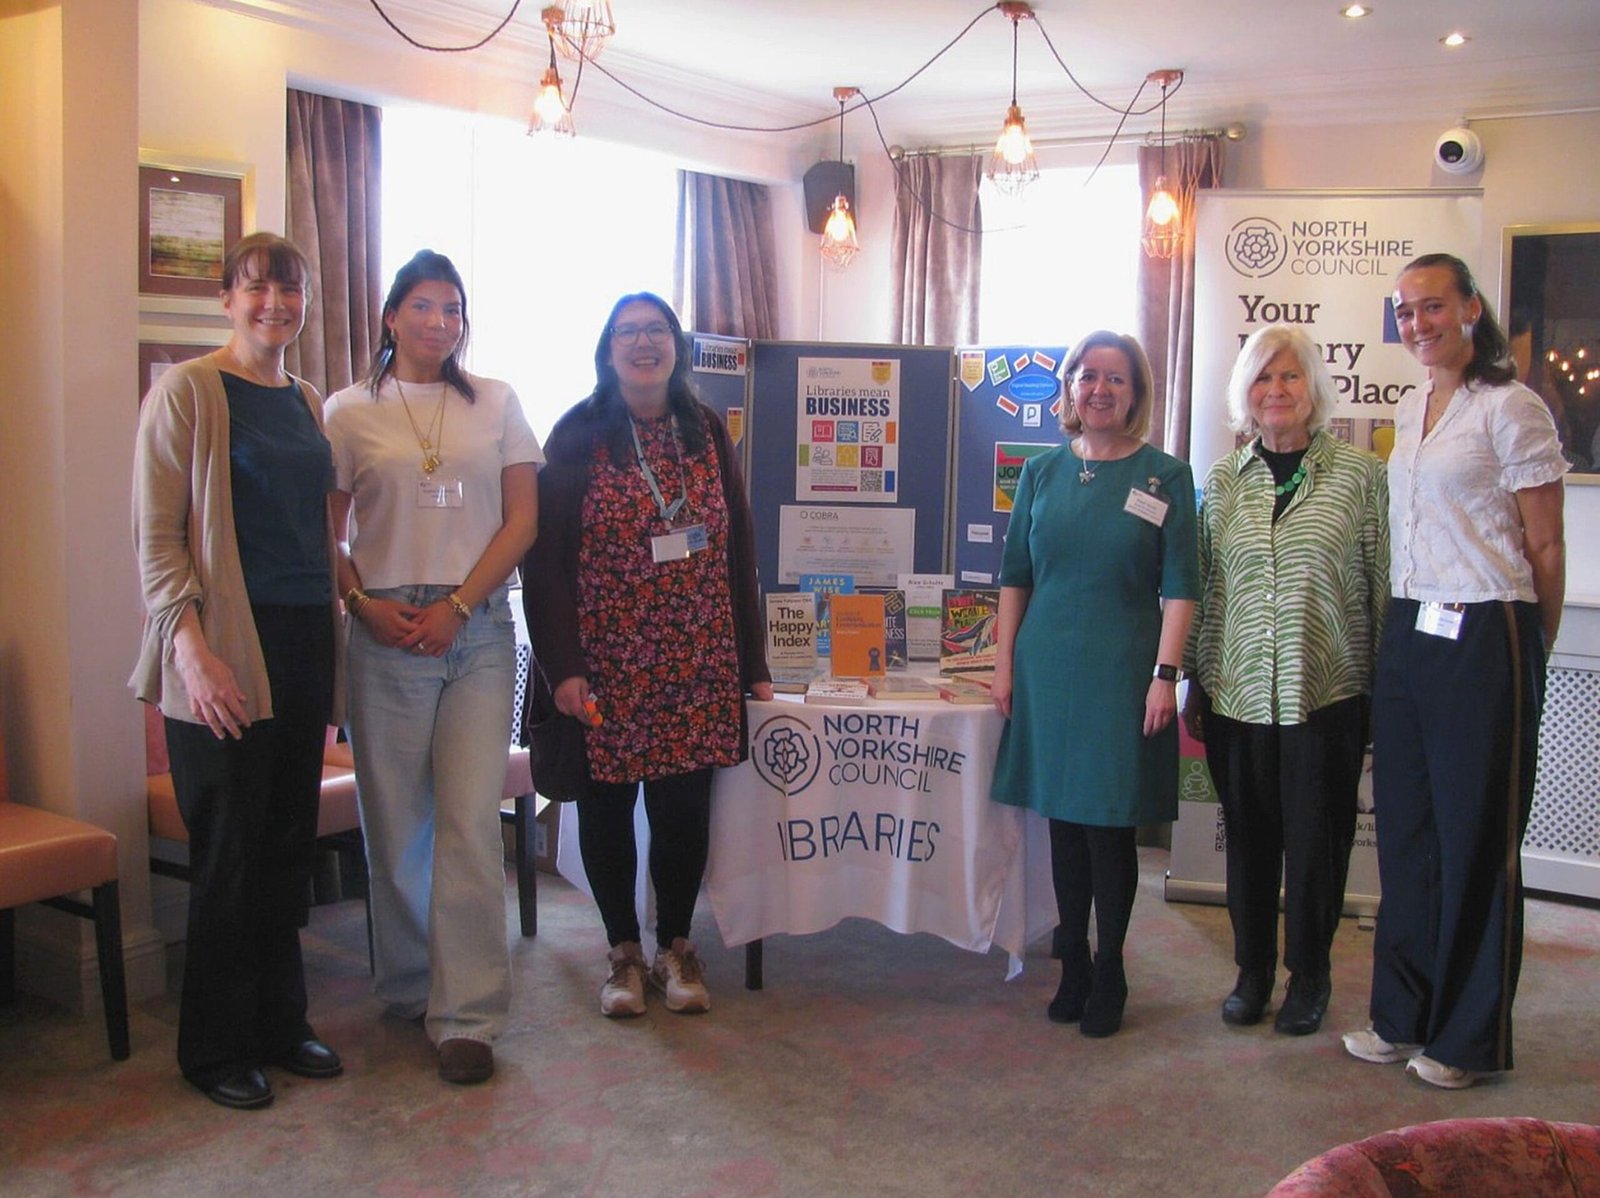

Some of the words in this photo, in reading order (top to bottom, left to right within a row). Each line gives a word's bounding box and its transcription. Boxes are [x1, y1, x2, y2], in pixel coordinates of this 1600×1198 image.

[1292, 221, 1367, 236] NORTH
[1292, 240, 1414, 256] YORKSHIRE
[1291, 259, 1388, 276] COUNCIL
[1238, 295, 1320, 324] Your
[701, 351, 738, 371] BUSINESS
[806, 385, 856, 397] Libraries
[859, 388, 890, 398] mean
[806, 397, 890, 417] BUSINESS
[809, 511, 839, 520] COBRA
[809, 577, 845, 586] JAMES
[777, 607, 804, 619] The
[769, 620, 814, 635] Happy
[773, 635, 811, 647] Index
[823, 714, 920, 739] NORTH
[826, 738, 967, 774] YORKSHIRE
[828, 762, 932, 793] COUNCIL
